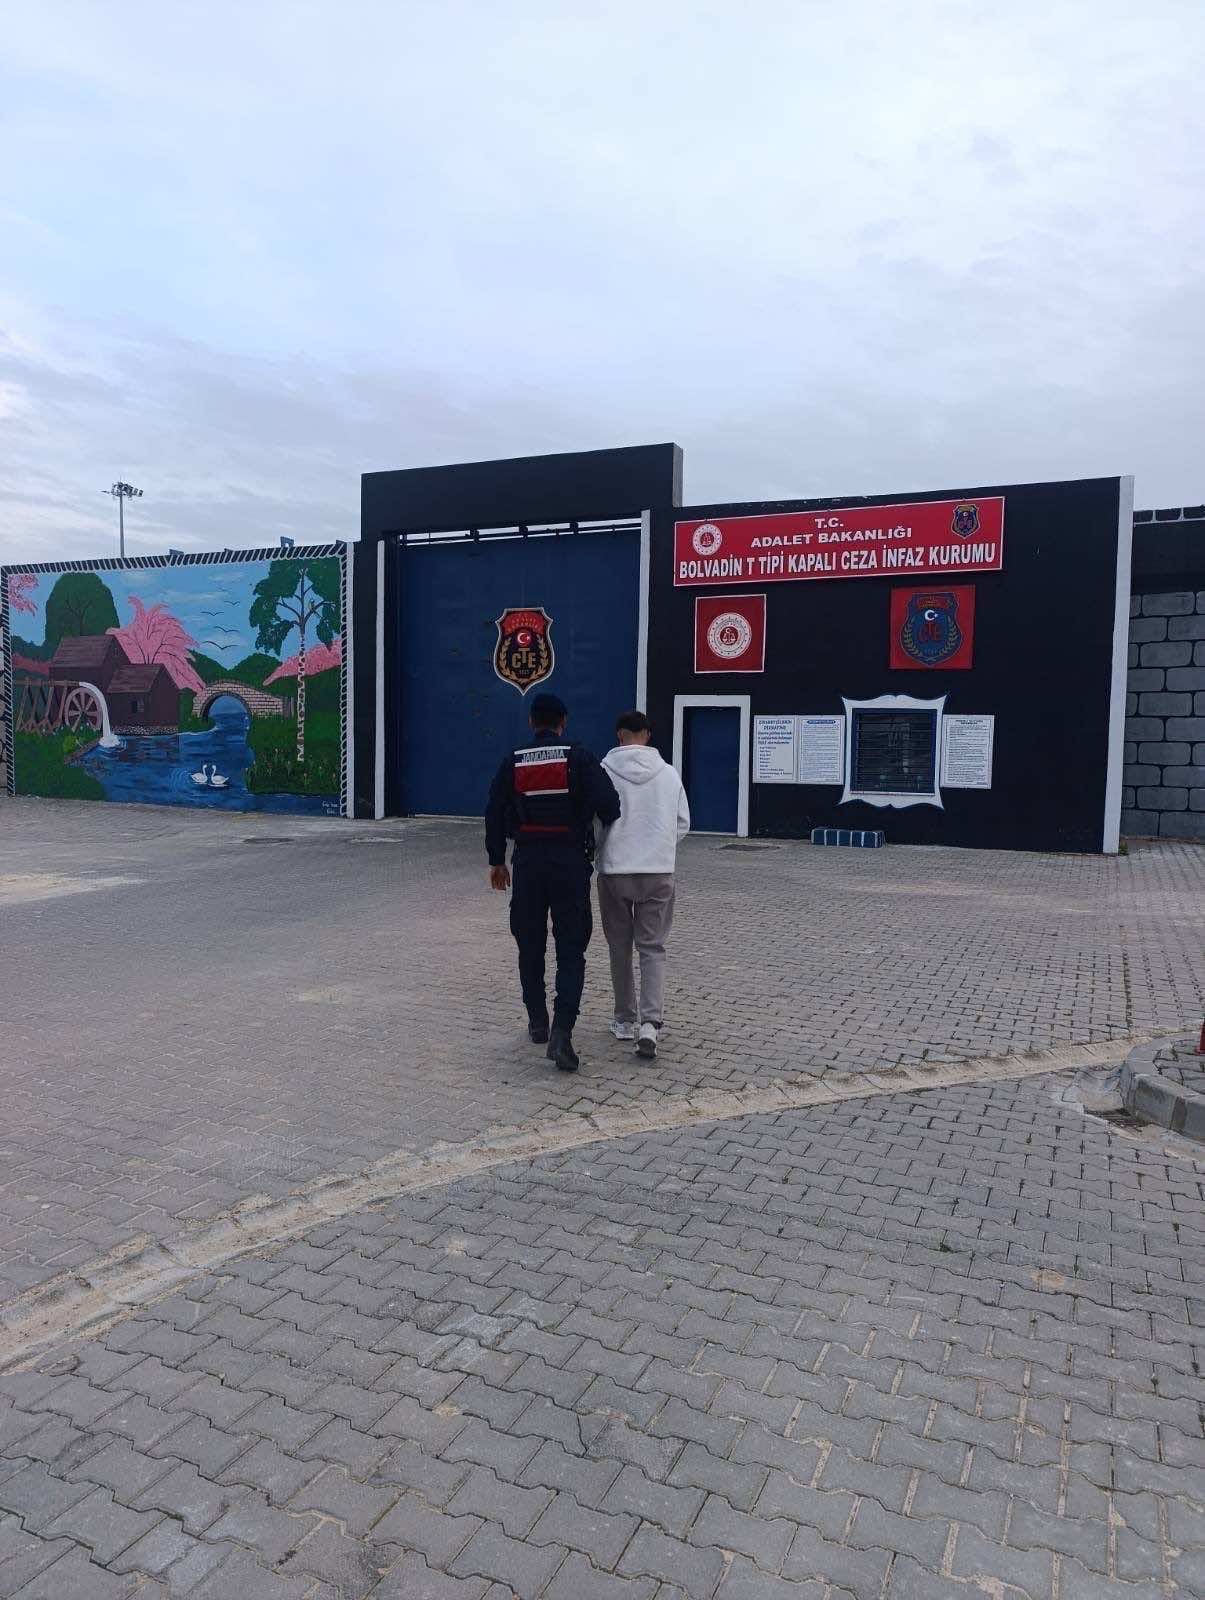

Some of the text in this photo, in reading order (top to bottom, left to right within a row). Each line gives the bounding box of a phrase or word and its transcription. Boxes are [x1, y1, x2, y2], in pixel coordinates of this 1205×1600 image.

[814, 517, 844, 529] T.C.
[750, 525, 912, 548] ADALET BAKANLIĞI
[679, 542, 996, 579] BOLVADİN T TİPİ KAPALI CEZA İNFAZ KURUMU
[521, 749, 566, 764] JANDARMA
